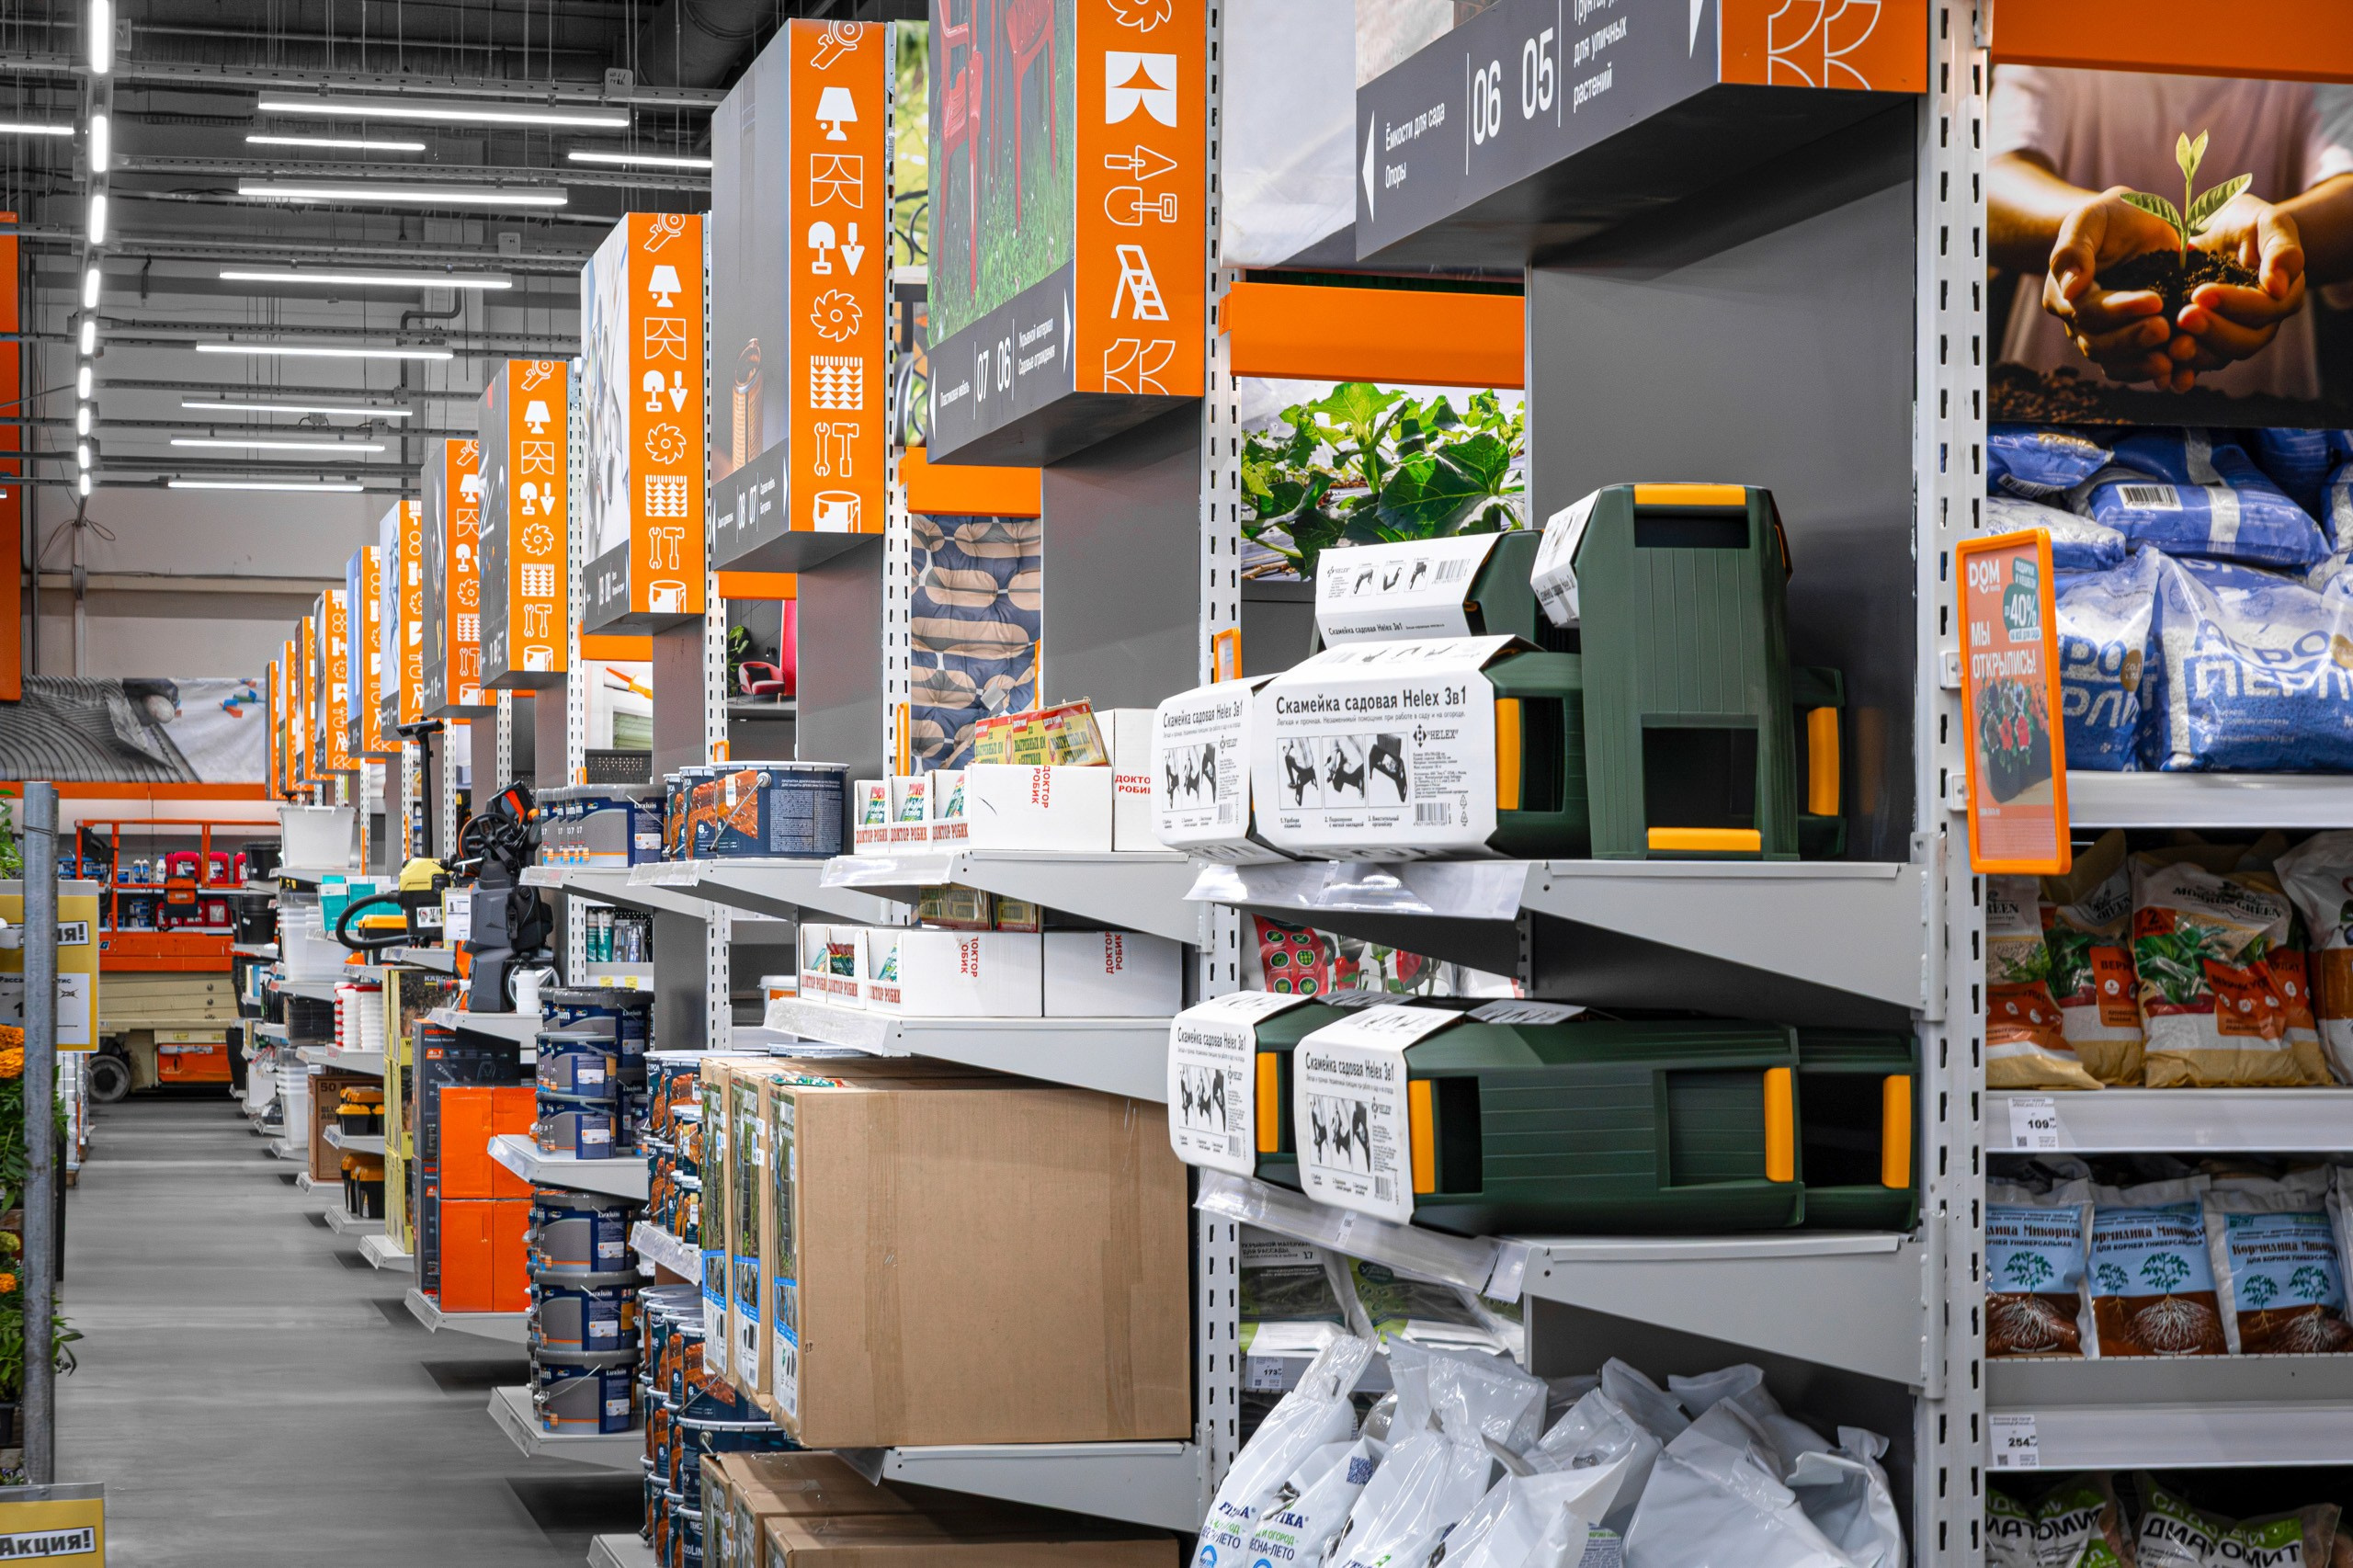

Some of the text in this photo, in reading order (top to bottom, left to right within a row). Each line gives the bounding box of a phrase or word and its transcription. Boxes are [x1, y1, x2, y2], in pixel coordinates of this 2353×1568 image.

[1574, 16, 1627, 68] для уличных
[1522, 27, 1553, 120] 05
[1573, 61, 1612, 114] растений
[1473, 60, 1501, 145] 06
[1385, 102, 1445, 152] Ёмкости для сада
[1385, 162, 1406, 189] Опоры
[977, 349, 989, 403] 07
[997, 336, 1011, 392] 06
[2010, 593, 2037, 627] 40%
[1328, 627, 1355, 636] Скамейка
[1355, 625, 1376, 634] садовая
[1378, 623, 1392, 631] Helex
[1971, 620, 1991, 647] МЫ
[1972, 649, 2036, 678] ОТКРЫЛИСЬ!
[1277, 685, 1466, 714] Скамейка садовая Helex 3в1
[1163, 709, 1191, 728] Скамейка
[1192, 710, 1214, 725] садовая
[1217, 703, 1233, 719] Helex
[1395, 712, 1413, 722] работе
[1418, 712, 1430, 722] саду
[1032, 768, 1040, 804] РОБИК
[1041, 766, 1051, 808] ДОКТОР
[1115, 775, 1150, 784] ДОКТО
[1119, 786, 1150, 794] РОБИ
[857, 828, 873, 844] ДОКТОР
[891, 827, 927, 844] ДОКТОР РОБИК
[933, 823, 968, 843] ДОКТОР РОБИК
[961, 944, 969, 973] ОБИК
[1106, 931, 1114, 974] ДОКТОР
[1115, 934, 1123, 971] РОБИК
[1177, 1027, 1202, 1045] Скамейка
[1203, 1034, 1222, 1049] садовая
[1223, 1032, 1237, 1050] Helex
[1306, 1051, 1337, 1074] Скамейка
[1338, 1061, 1363, 1078] садовая
[1365, 1060, 1381, 1080] Helex
[2028, 1119, 2050, 1129] 109
[2010, 1239, 2072, 1248] УНИВЕРСАЛЬНАЯ
[2024, 1224, 2080, 1239] Микориза
[2092, 1228, 2153, 1243] ормилица
[2114, 1242, 2143, 1250] КОРНЕЙ
[2232, 1241, 2298, 1256] Кормилица
[2246, 1255, 2290, 1265] ДЛЯ КОРНЕЙ
[2008, 1437, 2029, 1448] 254
[0, 1529, 90, 1556] Акция!
[1268, 1530, 1295, 1546] ОГОРОД
